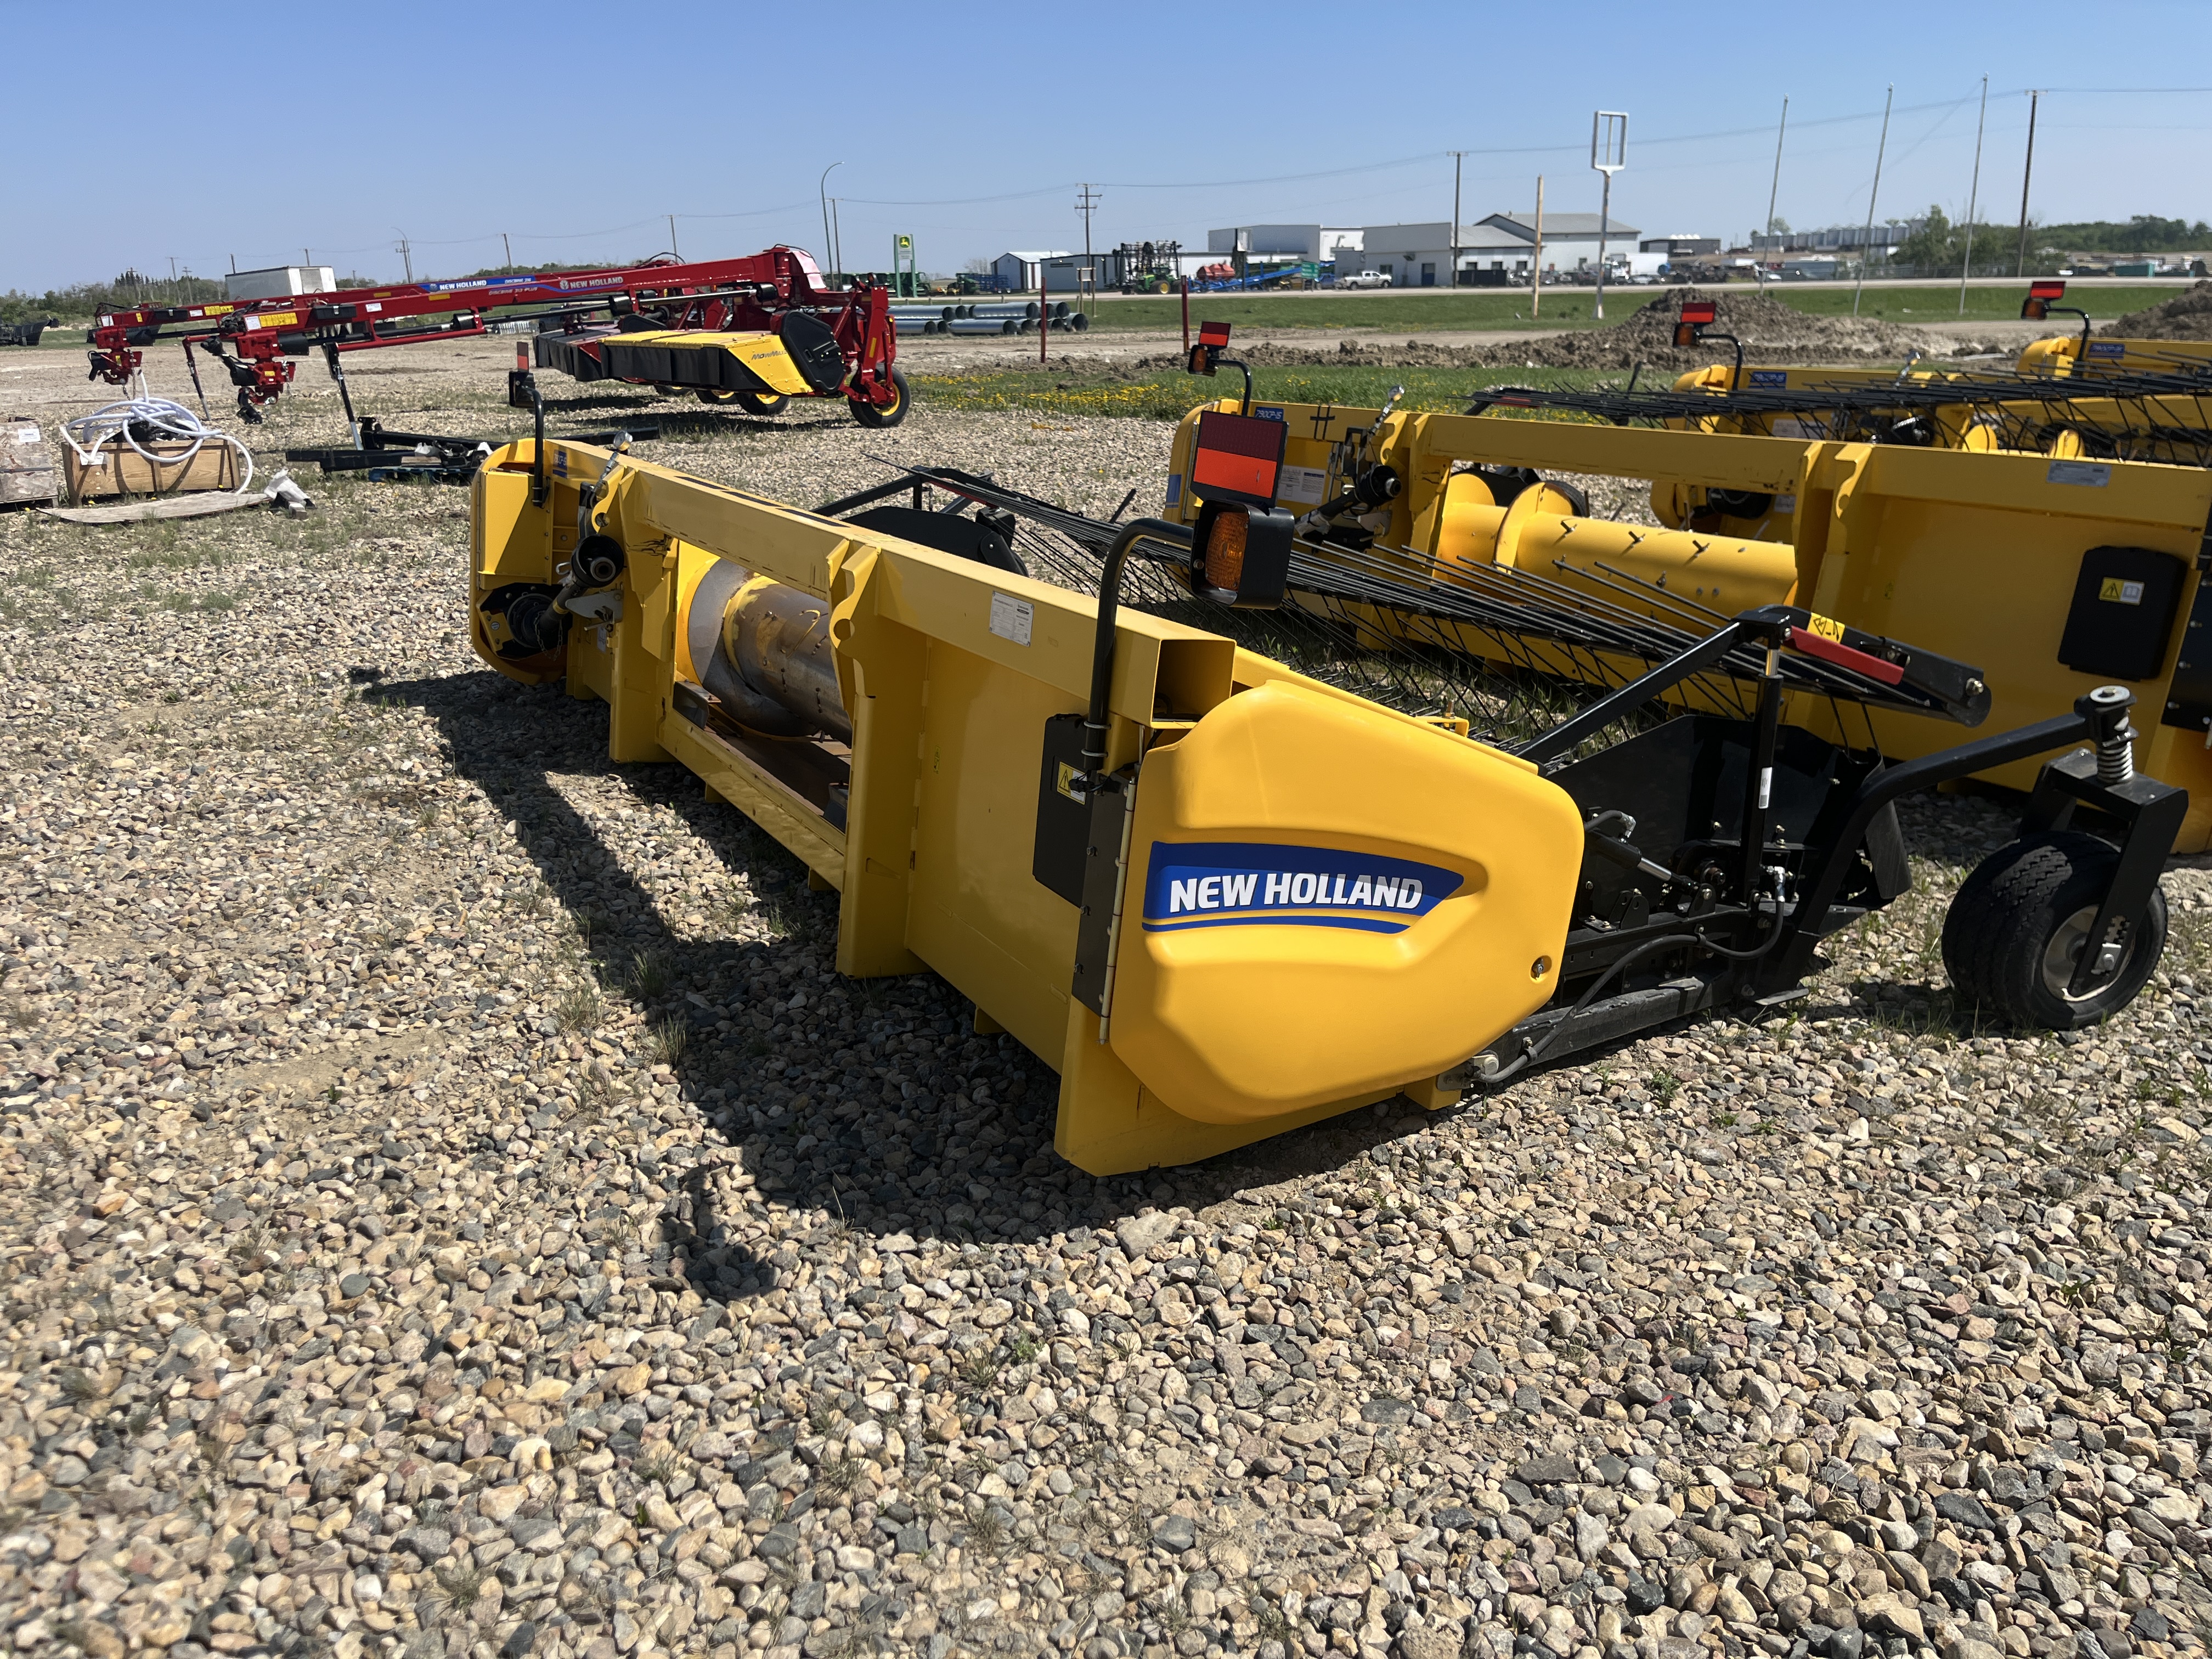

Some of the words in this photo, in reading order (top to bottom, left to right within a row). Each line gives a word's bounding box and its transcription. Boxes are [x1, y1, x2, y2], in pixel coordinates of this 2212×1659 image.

[456, 280, 487, 288] HOLLAND
[589, 276, 623, 286] HOLLAND
[1170, 873, 1259, 913] NEW
[1263, 872, 1424, 910] HOLLAND
